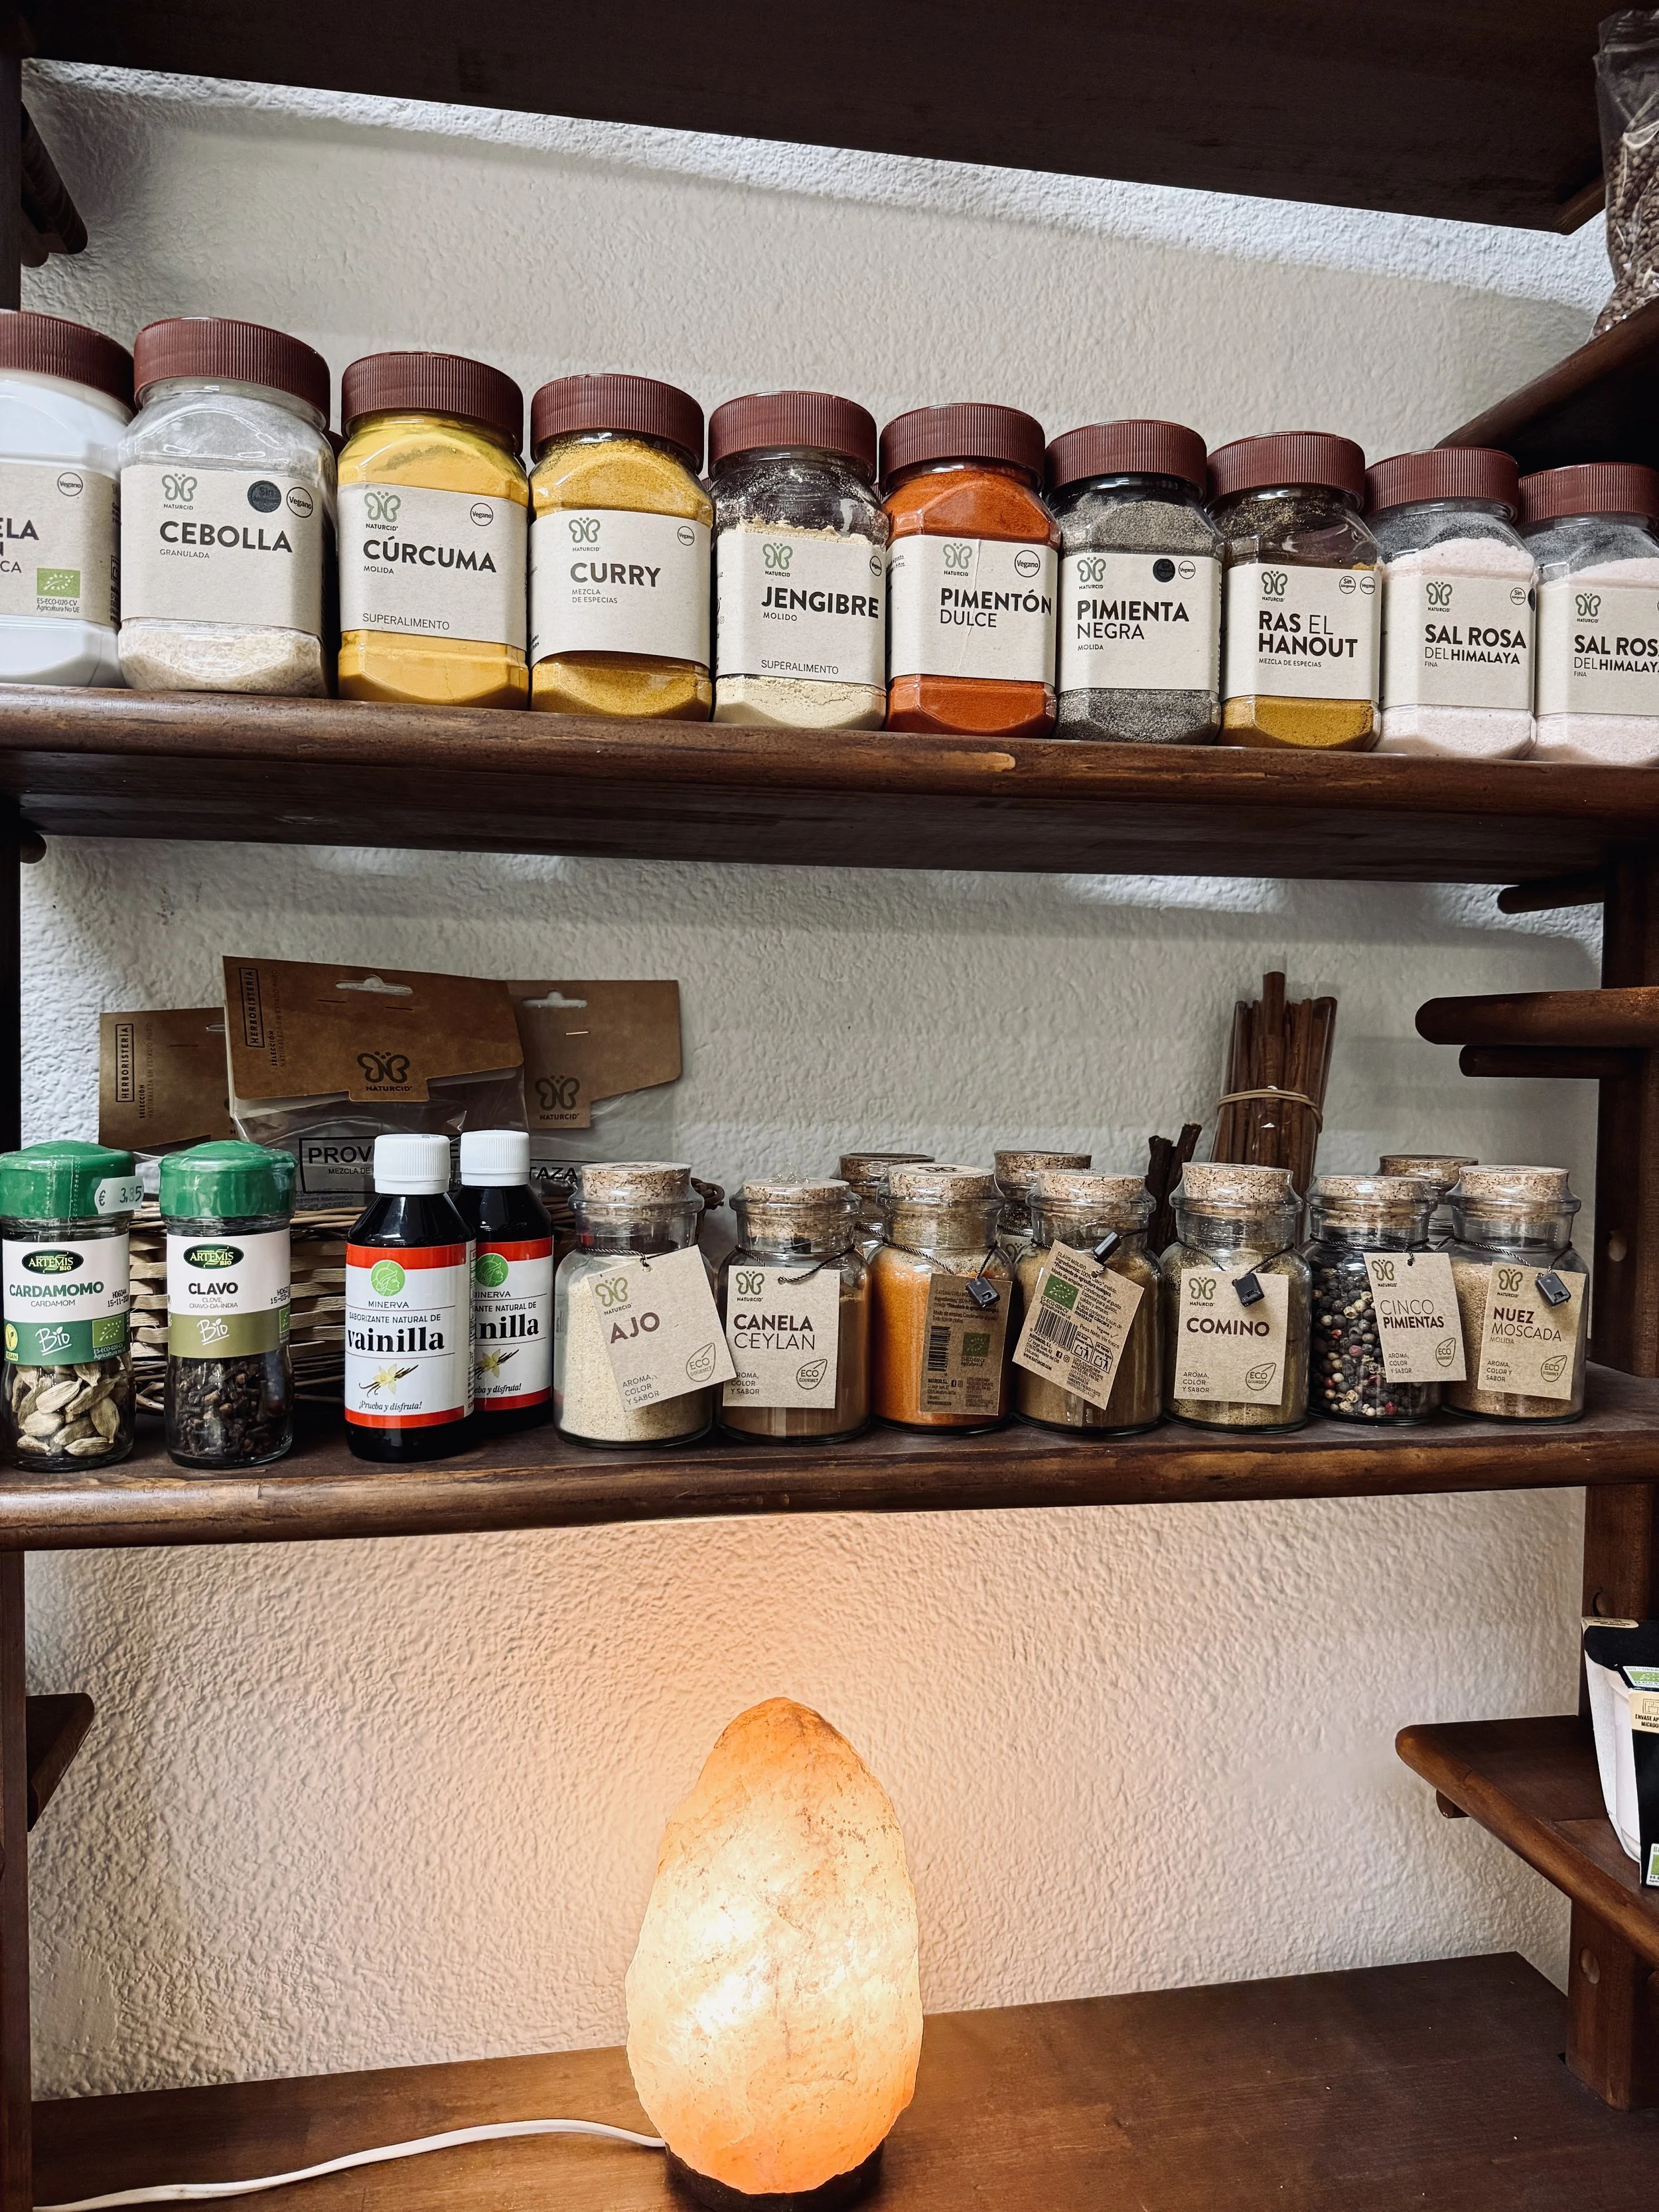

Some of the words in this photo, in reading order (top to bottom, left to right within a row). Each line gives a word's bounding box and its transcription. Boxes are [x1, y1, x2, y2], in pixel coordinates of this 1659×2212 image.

[289, 496, 312, 510] Vegano
[471, 510, 492, 520] Vegano
[0, 517, 39, 540] LA
[366, 523, 398, 532] NATURCID
[160, 521, 293, 553] CEBOLLA
[160, 549, 210, 559] GRANULADA
[363, 536, 497, 573] CÚRCUMA
[364, 565, 394, 575] MOLIDA
[571, 562, 662, 587] CURRY
[761, 586, 879, 619] JENGIBRE
[940, 588, 1052, 616] PIMENTÓN
[763, 612, 798, 621] MOLIDO
[940, 609, 997, 627] DULCE
[1078, 600, 1189, 622] PIMIENTA
[362, 613, 451, 630] SUPERALIMENTO
[1259, 611, 1301, 633] RAS
[1309, 615, 1334, 634] EL
[1078, 623, 1145, 640] NEGRA
[1425, 624, 1463, 645] SAL
[1469, 627, 1526, 648] ROSA
[1259, 632, 1358, 658] HANOUT
[1574, 634, 1611, 654] SAL
[1617, 637, 1659, 657] ROS
[1425, 646, 1449, 660] DEL
[1451, 649, 1520, 664] HIMALAYA
[761, 660, 839, 674] SUPERALIMENTO
[1574, 657, 1597, 670] DEL
[1599, 659, 1659, 673] HIMALAY
[243, 971, 259, 1044] HERBORISTERÍA
[268, 1030, 277, 1067] SELECCIÓN
[119, 1027, 129, 1098] HERBORISTERÍA
[119, 1186, 142, 1203] 3,85
[29, 1254, 74, 1268] ARTEMIS
[190, 1251, 234, 1262] ARTEMIS
[1055, 1256, 1080, 1274] Ingredientes:
[1056, 1251, 1070, 1262] CLAVO
[1070, 1258, 1086, 1270] MOLIDO
[9, 1281, 104, 1297] CARDAMOMO
[188, 1282, 238, 1295] CLAVO
[1050, 1267, 1062, 1276] Modo
[1083, 1285, 1107, 1301] Condimentar
[31, 1299, 76, 1307] CARDAMOM
[496, 1303, 526, 1311] NATURAL
[1079, 1295, 1092, 1305] caldos
[1096, 1299, 1105, 1307] para
[1380, 1299, 1434, 1315] CINCO
[349, 1311, 390, 1323] SABORIZANTE
[392, 1315, 427, 1323] NATURAL
[604, 1303, 632, 1315] NATURCID
[1493, 1307, 1535, 1324] NUEZ
[197, 1318, 228, 1342] Bio
[474, 1313, 539, 1339] nilla
[610, 1312, 660, 1344] AJO
[733, 1314, 814, 1332] CANELA
[1079, 1323, 1090, 1332] Peso
[1187, 1317, 1269, 1337] COMINO
[1383, 1316, 1444, 1328] PIMIENTAS
[35, 1327, 70, 1352] Bio
[348, 1326, 445, 1353] vainilla
[1095, 1325, 1110, 1337] Vegano
[1492, 1323, 1561, 1342] MOSCADA
[734, 1333, 815, 1350] CEYLAN
[94, 1351, 117, 1360] Agricultura
[689, 1358, 711, 1370] ECO
[801, 1369, 819, 1378] ECO
[493, 1383, 522, 1394] disfruta!
[624, 1383, 652, 1397] COLOR
[634, 1390, 660, 1404] SABOR
[359, 1401, 384, 1411] ¡Prueba
[384, 1404, 389, 1412] y
[390, 1402, 422, 1412] disfruta!
